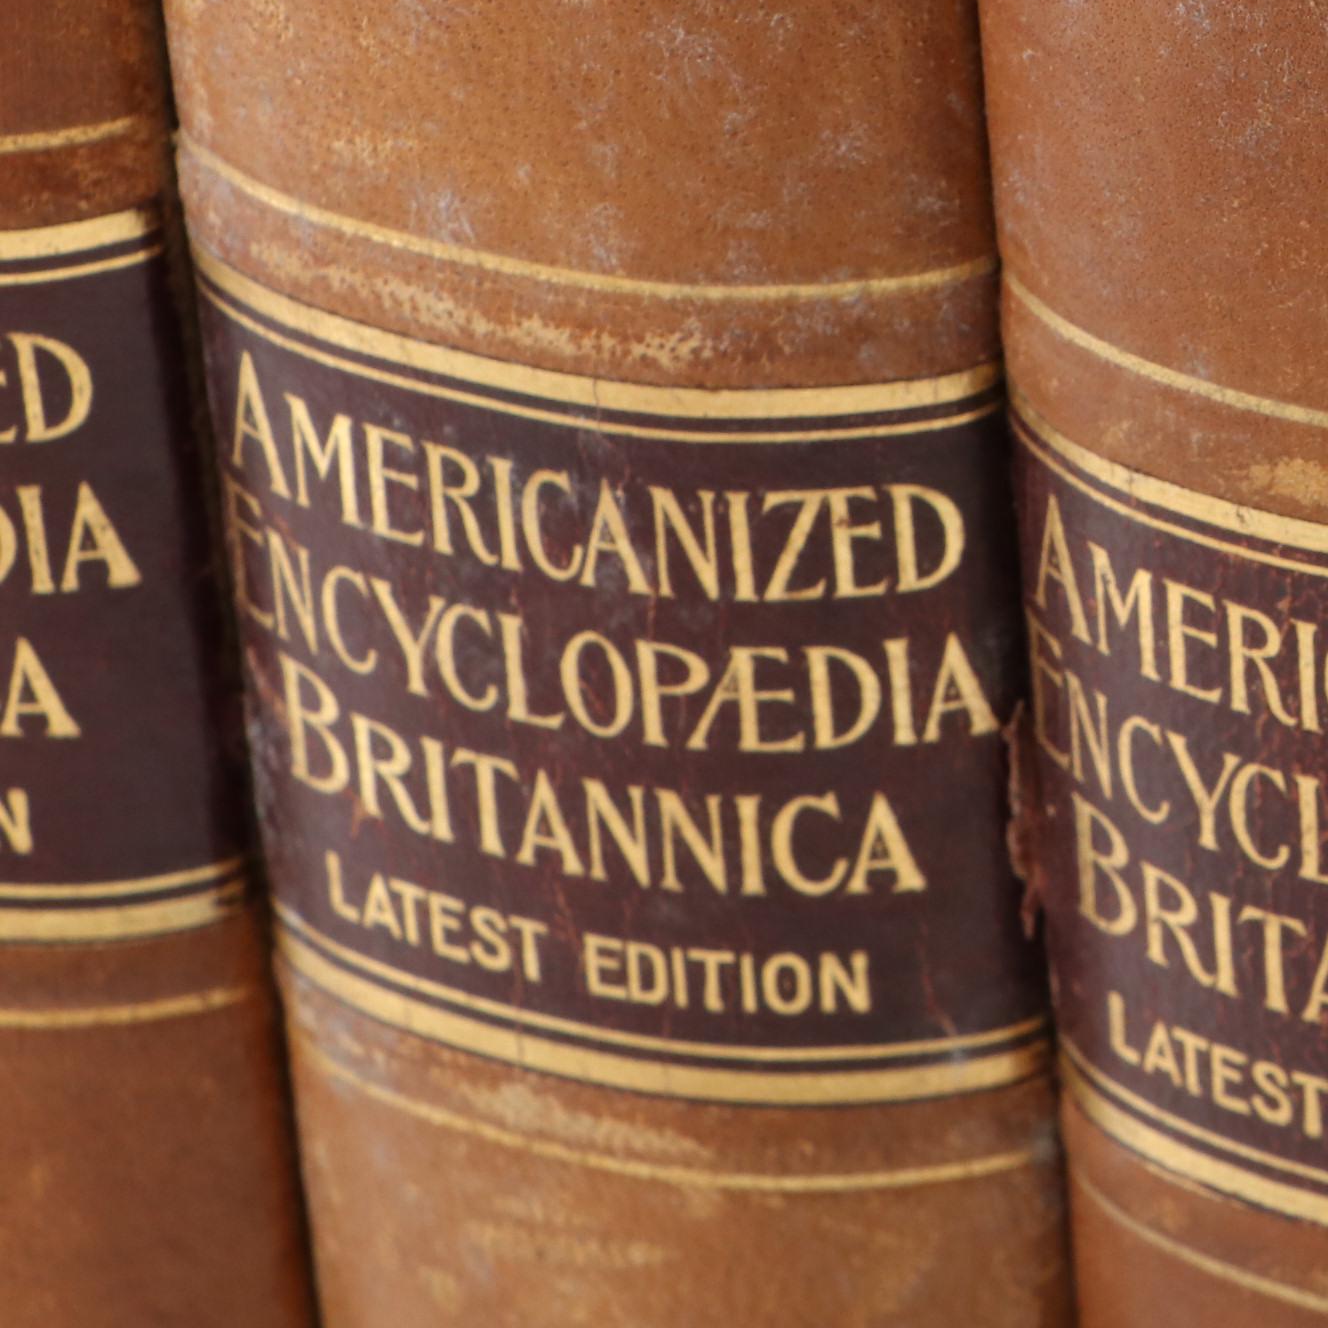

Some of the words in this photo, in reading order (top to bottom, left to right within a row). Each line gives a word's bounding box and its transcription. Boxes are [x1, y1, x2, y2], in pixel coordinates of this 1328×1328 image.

[0, 332, 93, 444] D
[0, 481, 142, 594] IA
[233, 351, 966, 602] AMERICANIZED
[277, 652, 927, 896] BRITANNICA
[325, 852, 549, 981] LATEST
[584, 936, 871, 1014] EDITION
